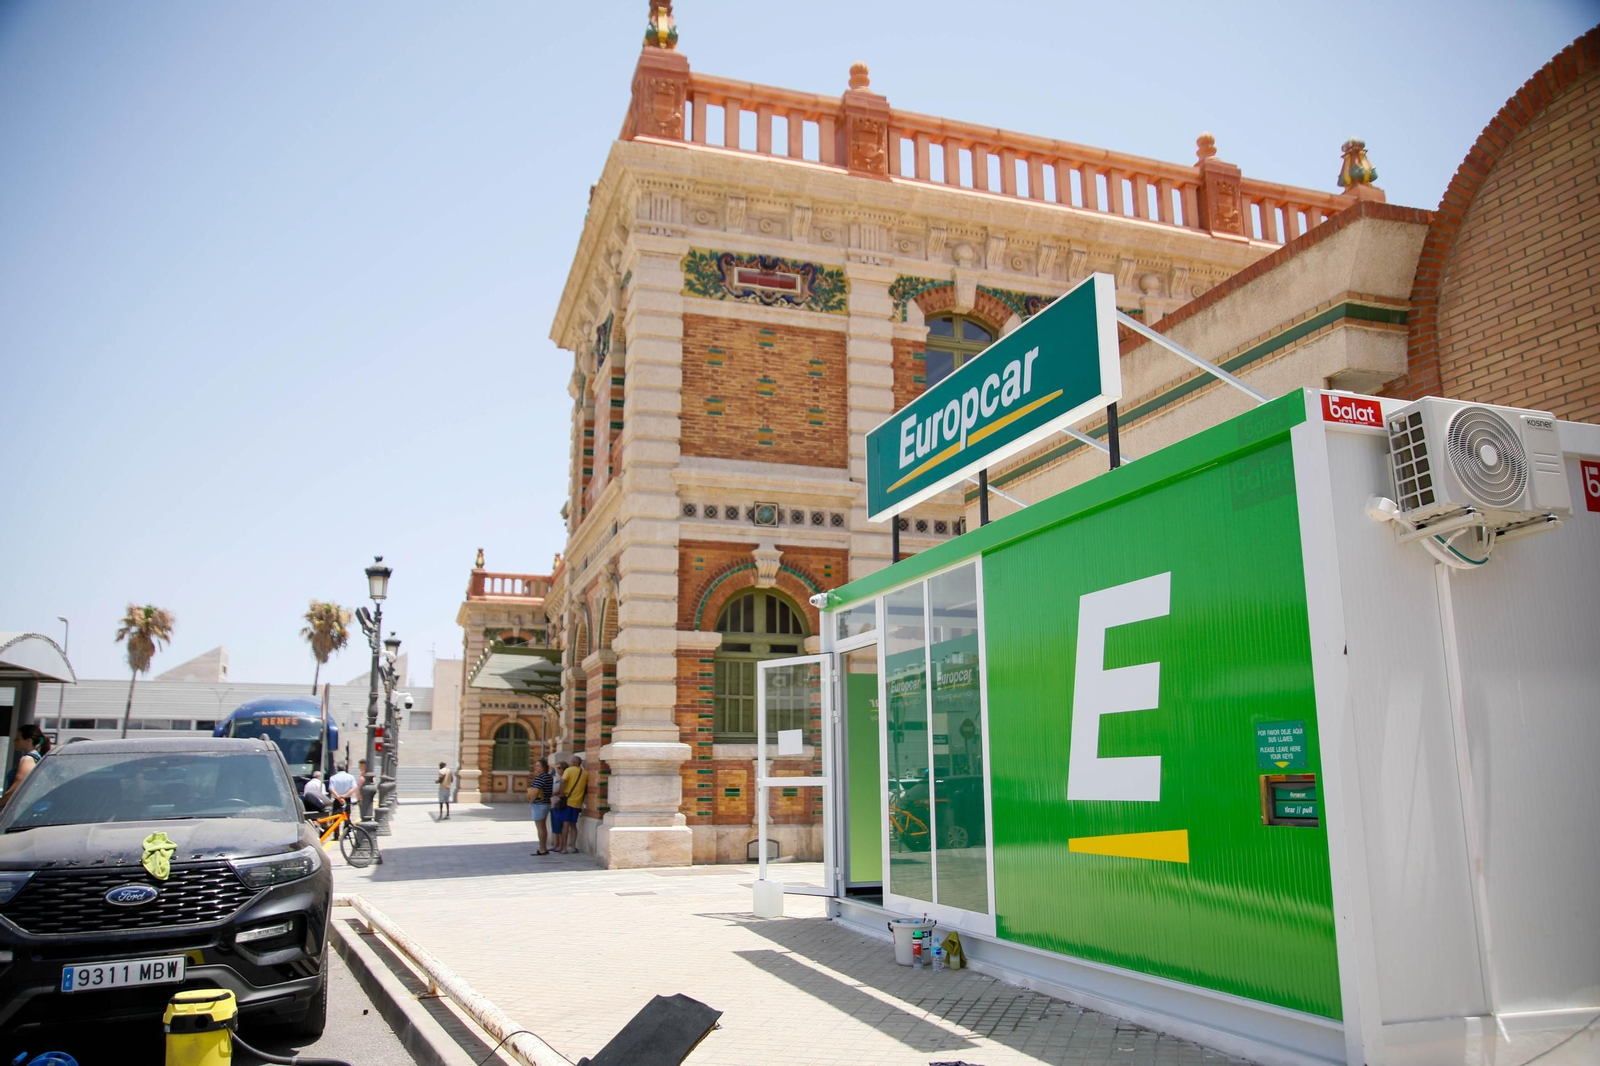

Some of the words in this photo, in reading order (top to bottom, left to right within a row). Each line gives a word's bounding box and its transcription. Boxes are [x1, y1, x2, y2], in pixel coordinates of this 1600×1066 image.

[899, 346, 1039, 469] Europcar
[1328, 396, 1375, 422] balat
[890, 678, 921, 694] Europcar
[937, 669, 972, 686] Europcar
[1066, 571, 1172, 803] E
[261, 716, 298, 726] RENFE
[1302, 806, 1313, 814] pull
[117, 889, 146, 902] Ford
[78, 964, 129, 987] 9311
[139, 961, 178, 981] MBW
